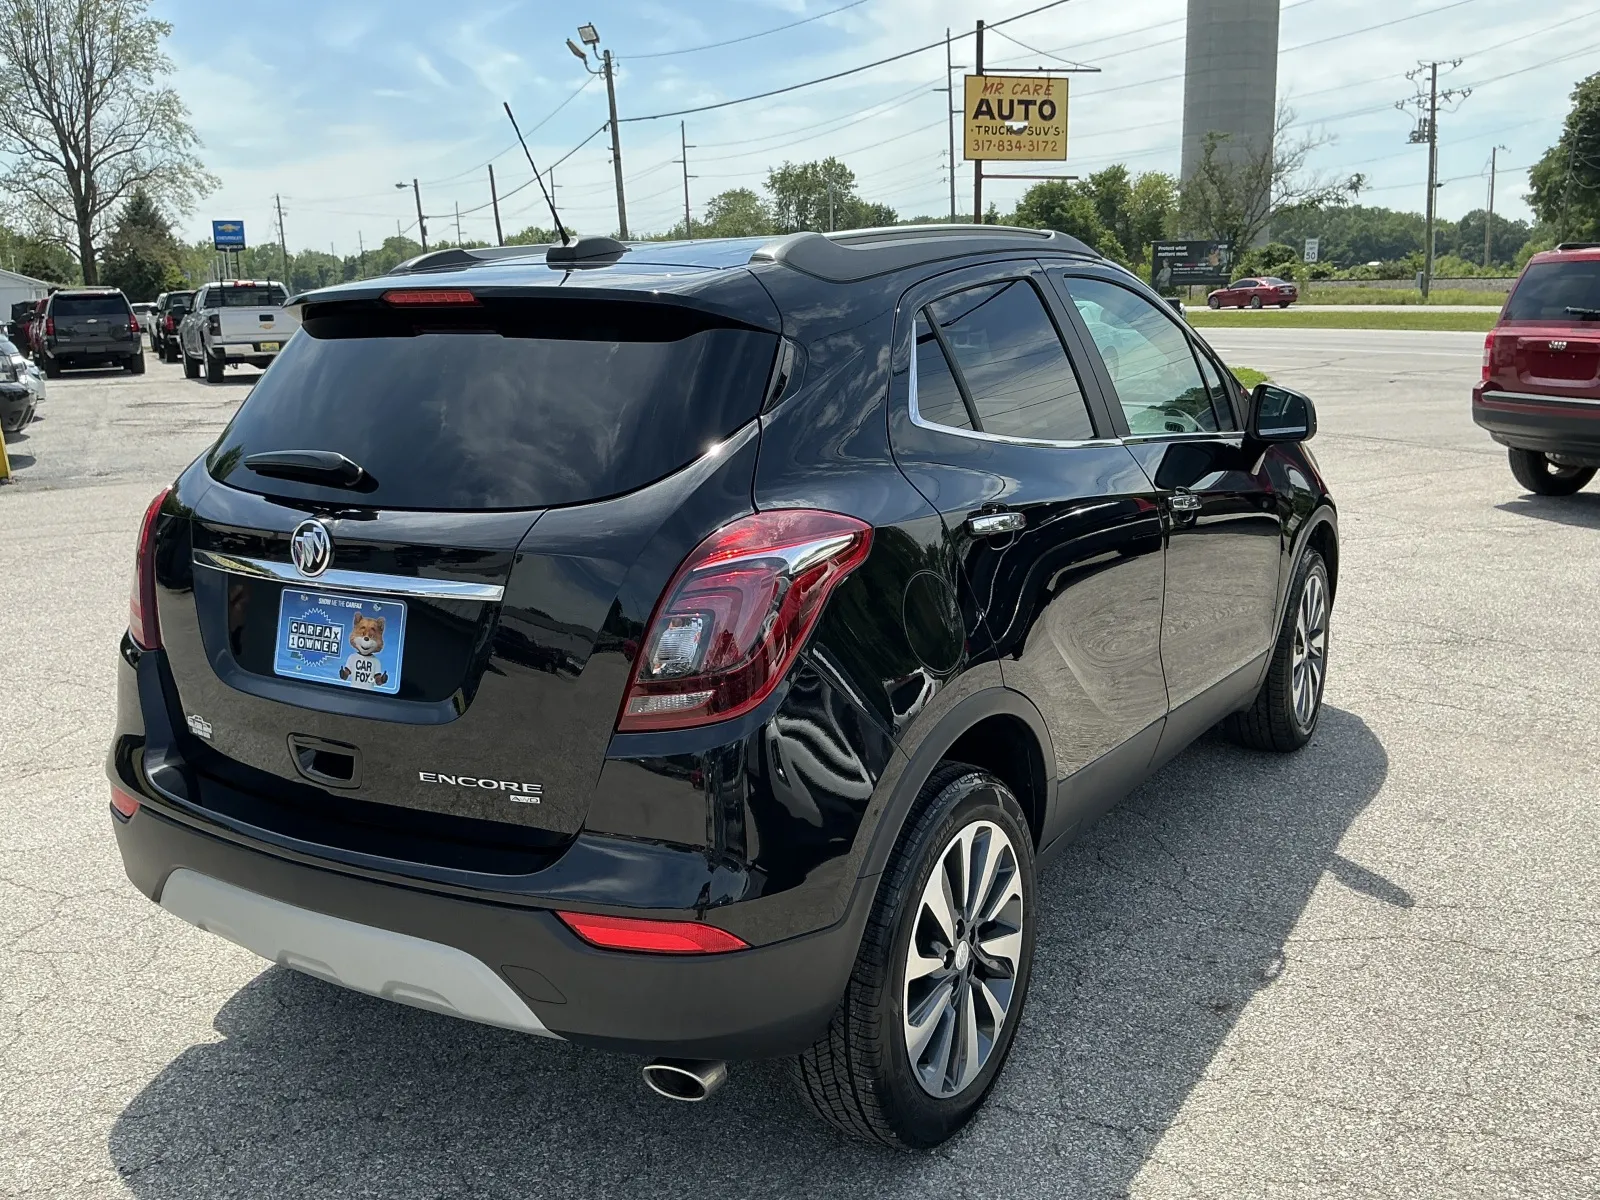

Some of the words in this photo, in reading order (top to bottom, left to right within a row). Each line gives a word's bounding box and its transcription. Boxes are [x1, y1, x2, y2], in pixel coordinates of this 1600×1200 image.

[1011, 83, 1054, 96] CARE
[972, 98, 1057, 121] AUTO
[1027, 125, 1061, 137] SUV'S
[1305, 251, 1316, 260] 50
[345, 601, 362, 609] CARFAX
[291, 621, 340, 640] CARFAX
[355, 659, 373, 672] CAR
[419, 771, 543, 794] ENCORE
[510, 795, 540, 803] AWD
